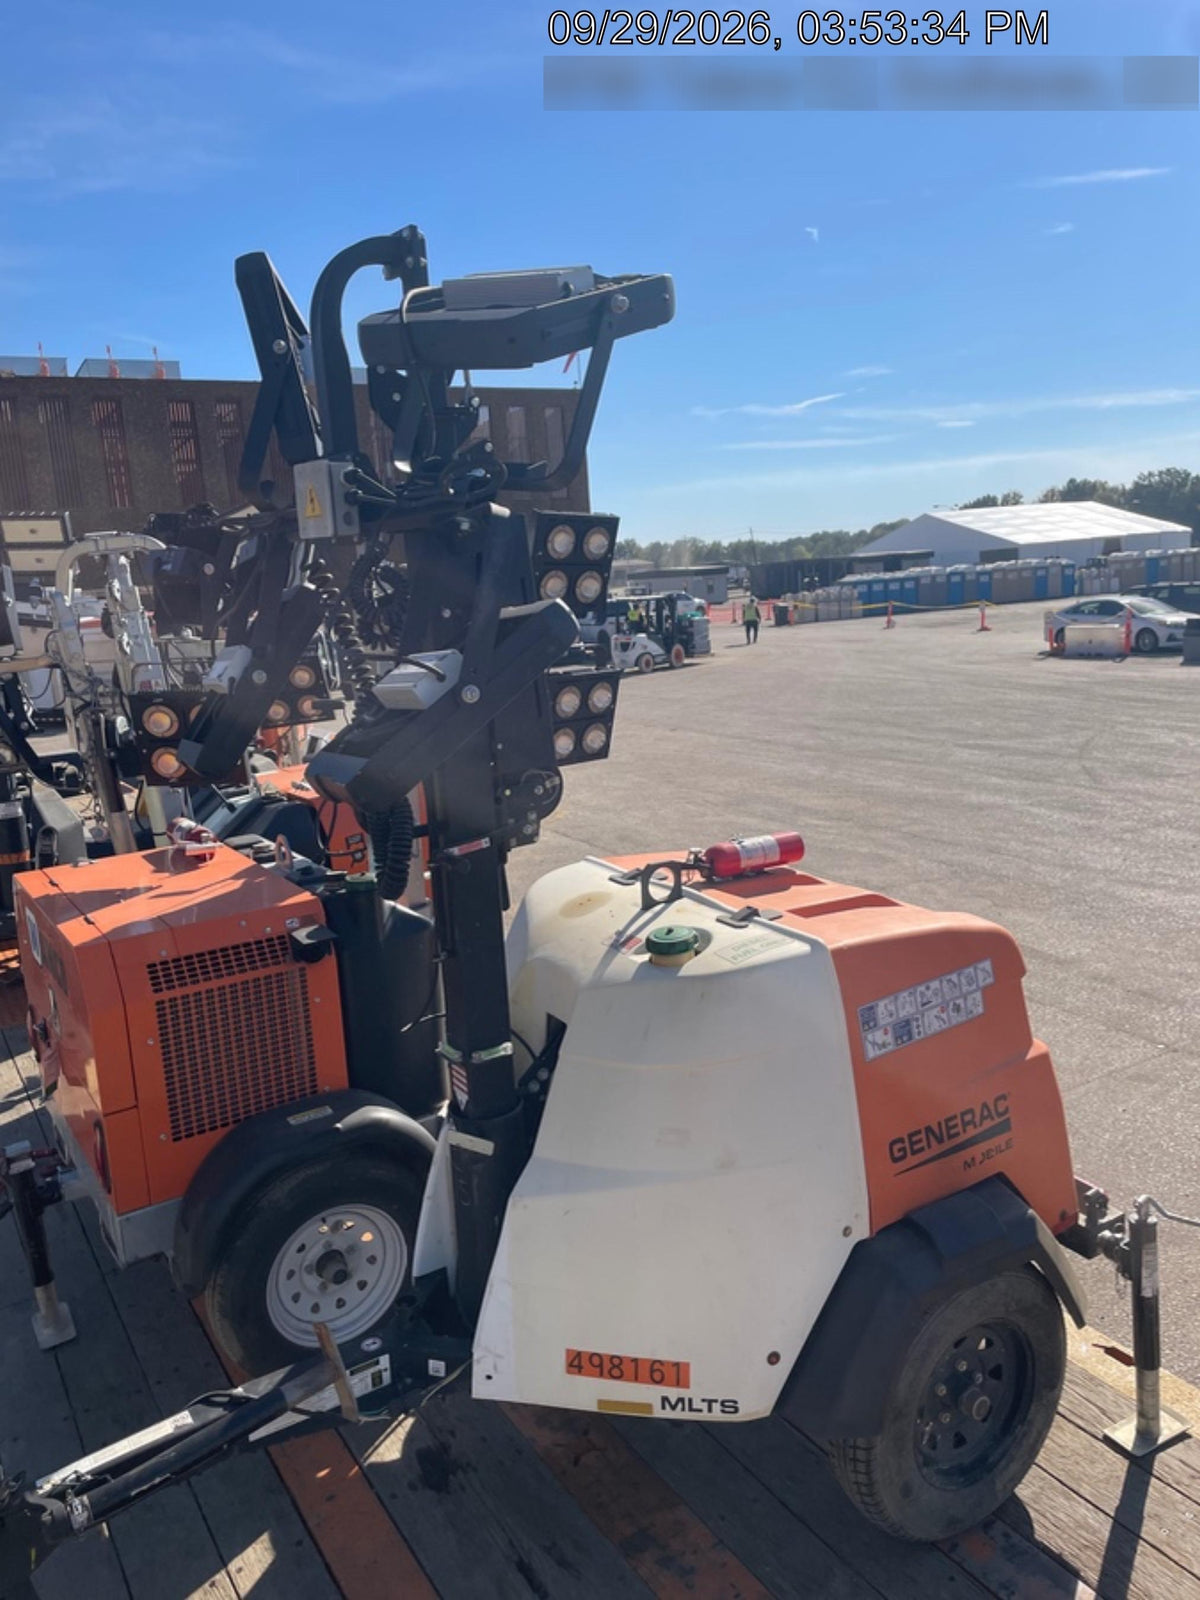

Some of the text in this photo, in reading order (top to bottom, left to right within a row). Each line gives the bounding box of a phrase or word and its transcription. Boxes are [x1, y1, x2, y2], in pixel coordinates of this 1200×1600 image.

[888, 1093, 1010, 1164] GENERAC
[568, 1351, 681, 1386] 498161
[661, 1395, 739, 1414] MLTS
